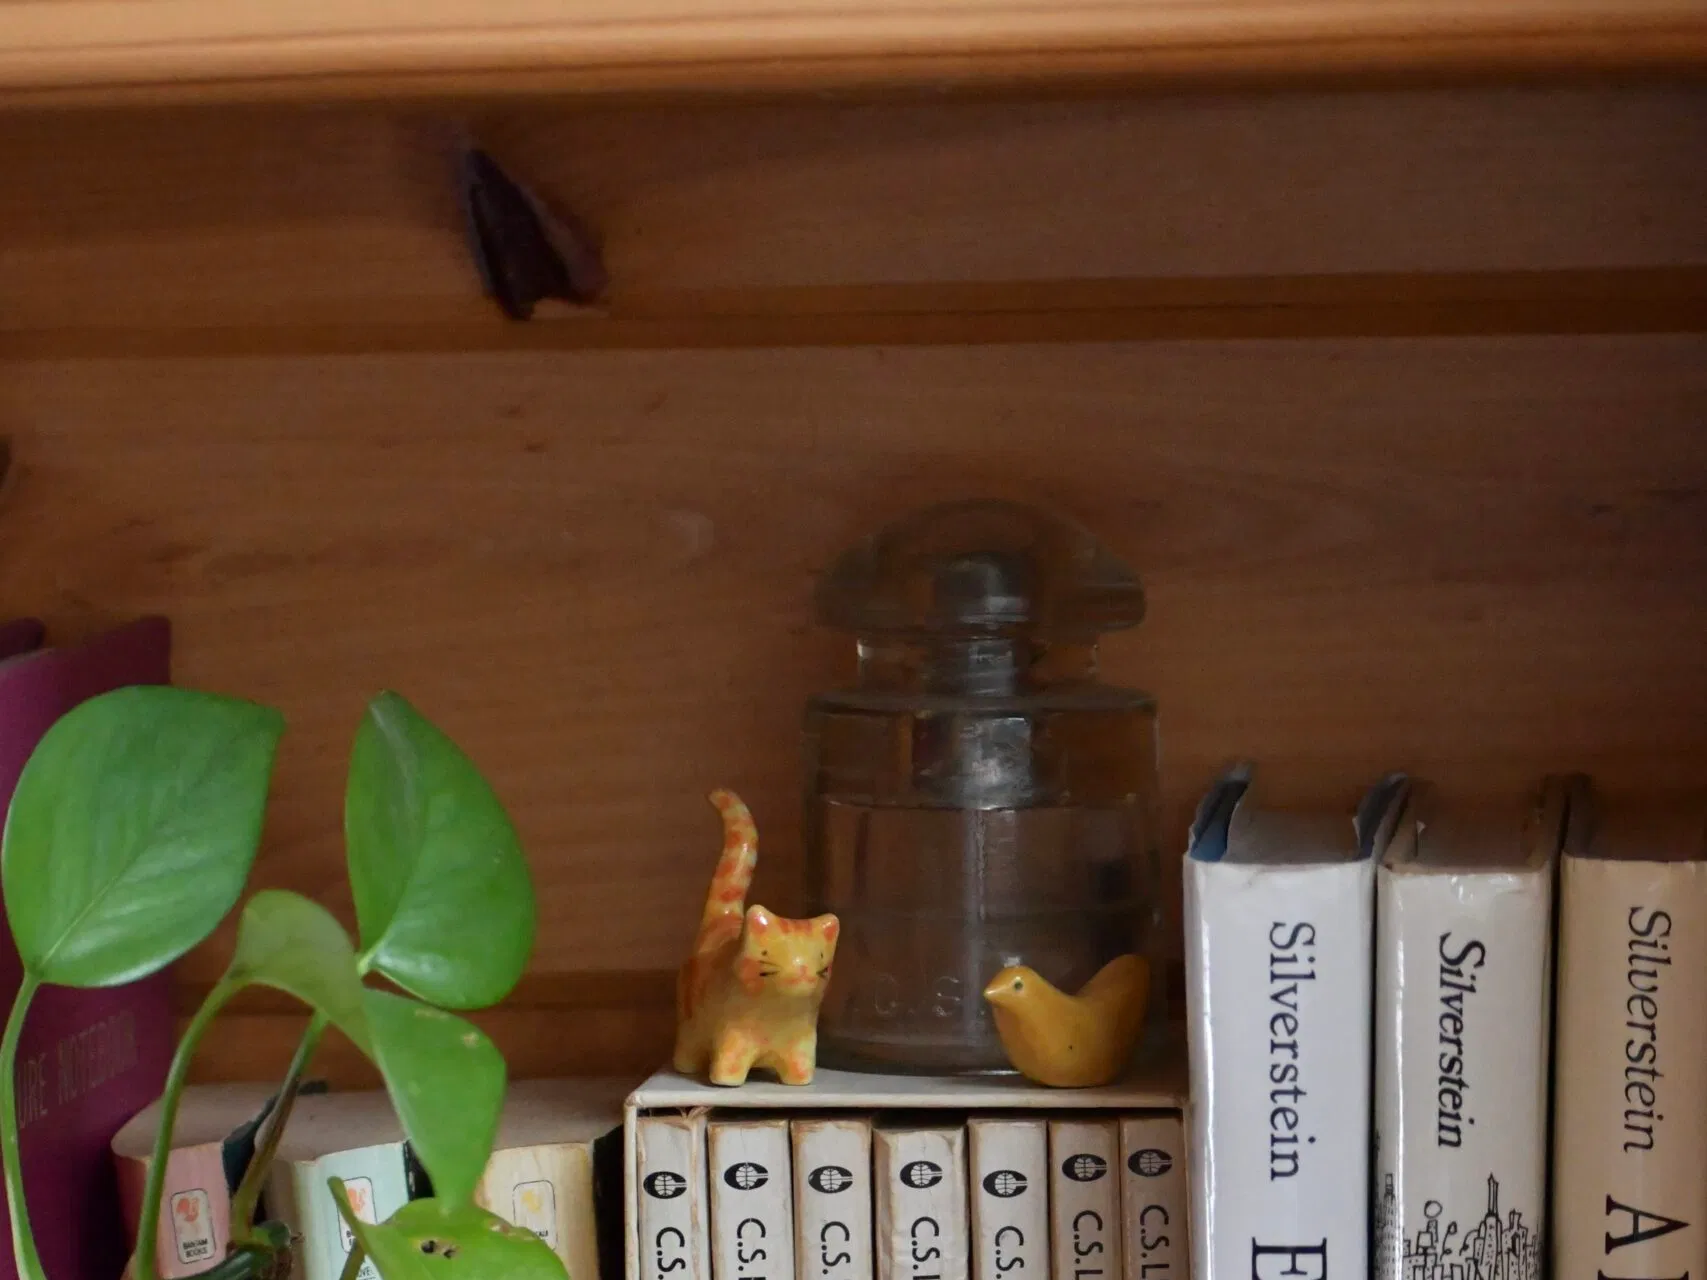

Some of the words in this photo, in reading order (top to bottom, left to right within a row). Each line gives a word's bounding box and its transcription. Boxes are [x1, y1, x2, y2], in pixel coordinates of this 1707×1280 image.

[1270, 922, 1316, 1181] Silverstein
[1438, 932, 1486, 1147] Silverstein
[1624, 907, 1672, 1152] Silverstein
[1605, 1195, 1691, 1255] A
